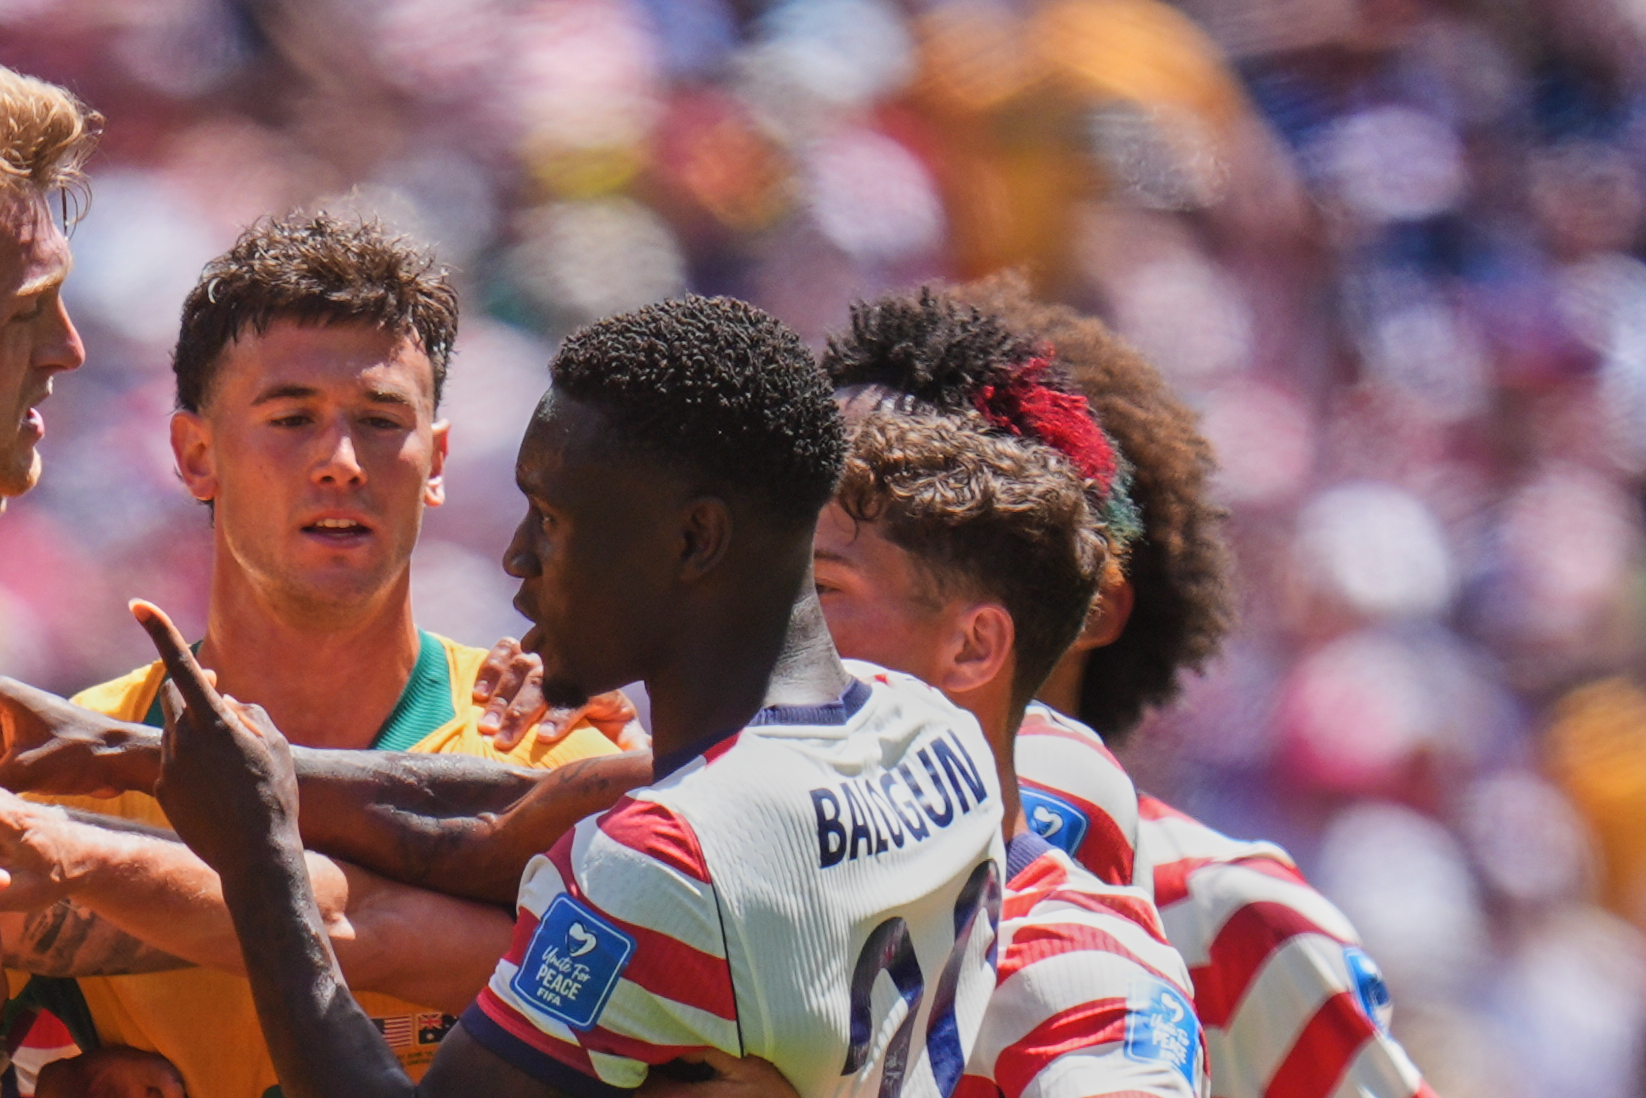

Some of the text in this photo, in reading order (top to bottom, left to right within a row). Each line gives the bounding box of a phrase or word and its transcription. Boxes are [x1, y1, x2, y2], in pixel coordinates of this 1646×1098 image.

[810, 729, 988, 869] BALOGUN
[536, 964, 582, 1000] PEACE
[542, 945, 592, 983] Unite For
[536, 988, 561, 1006] FIFA
